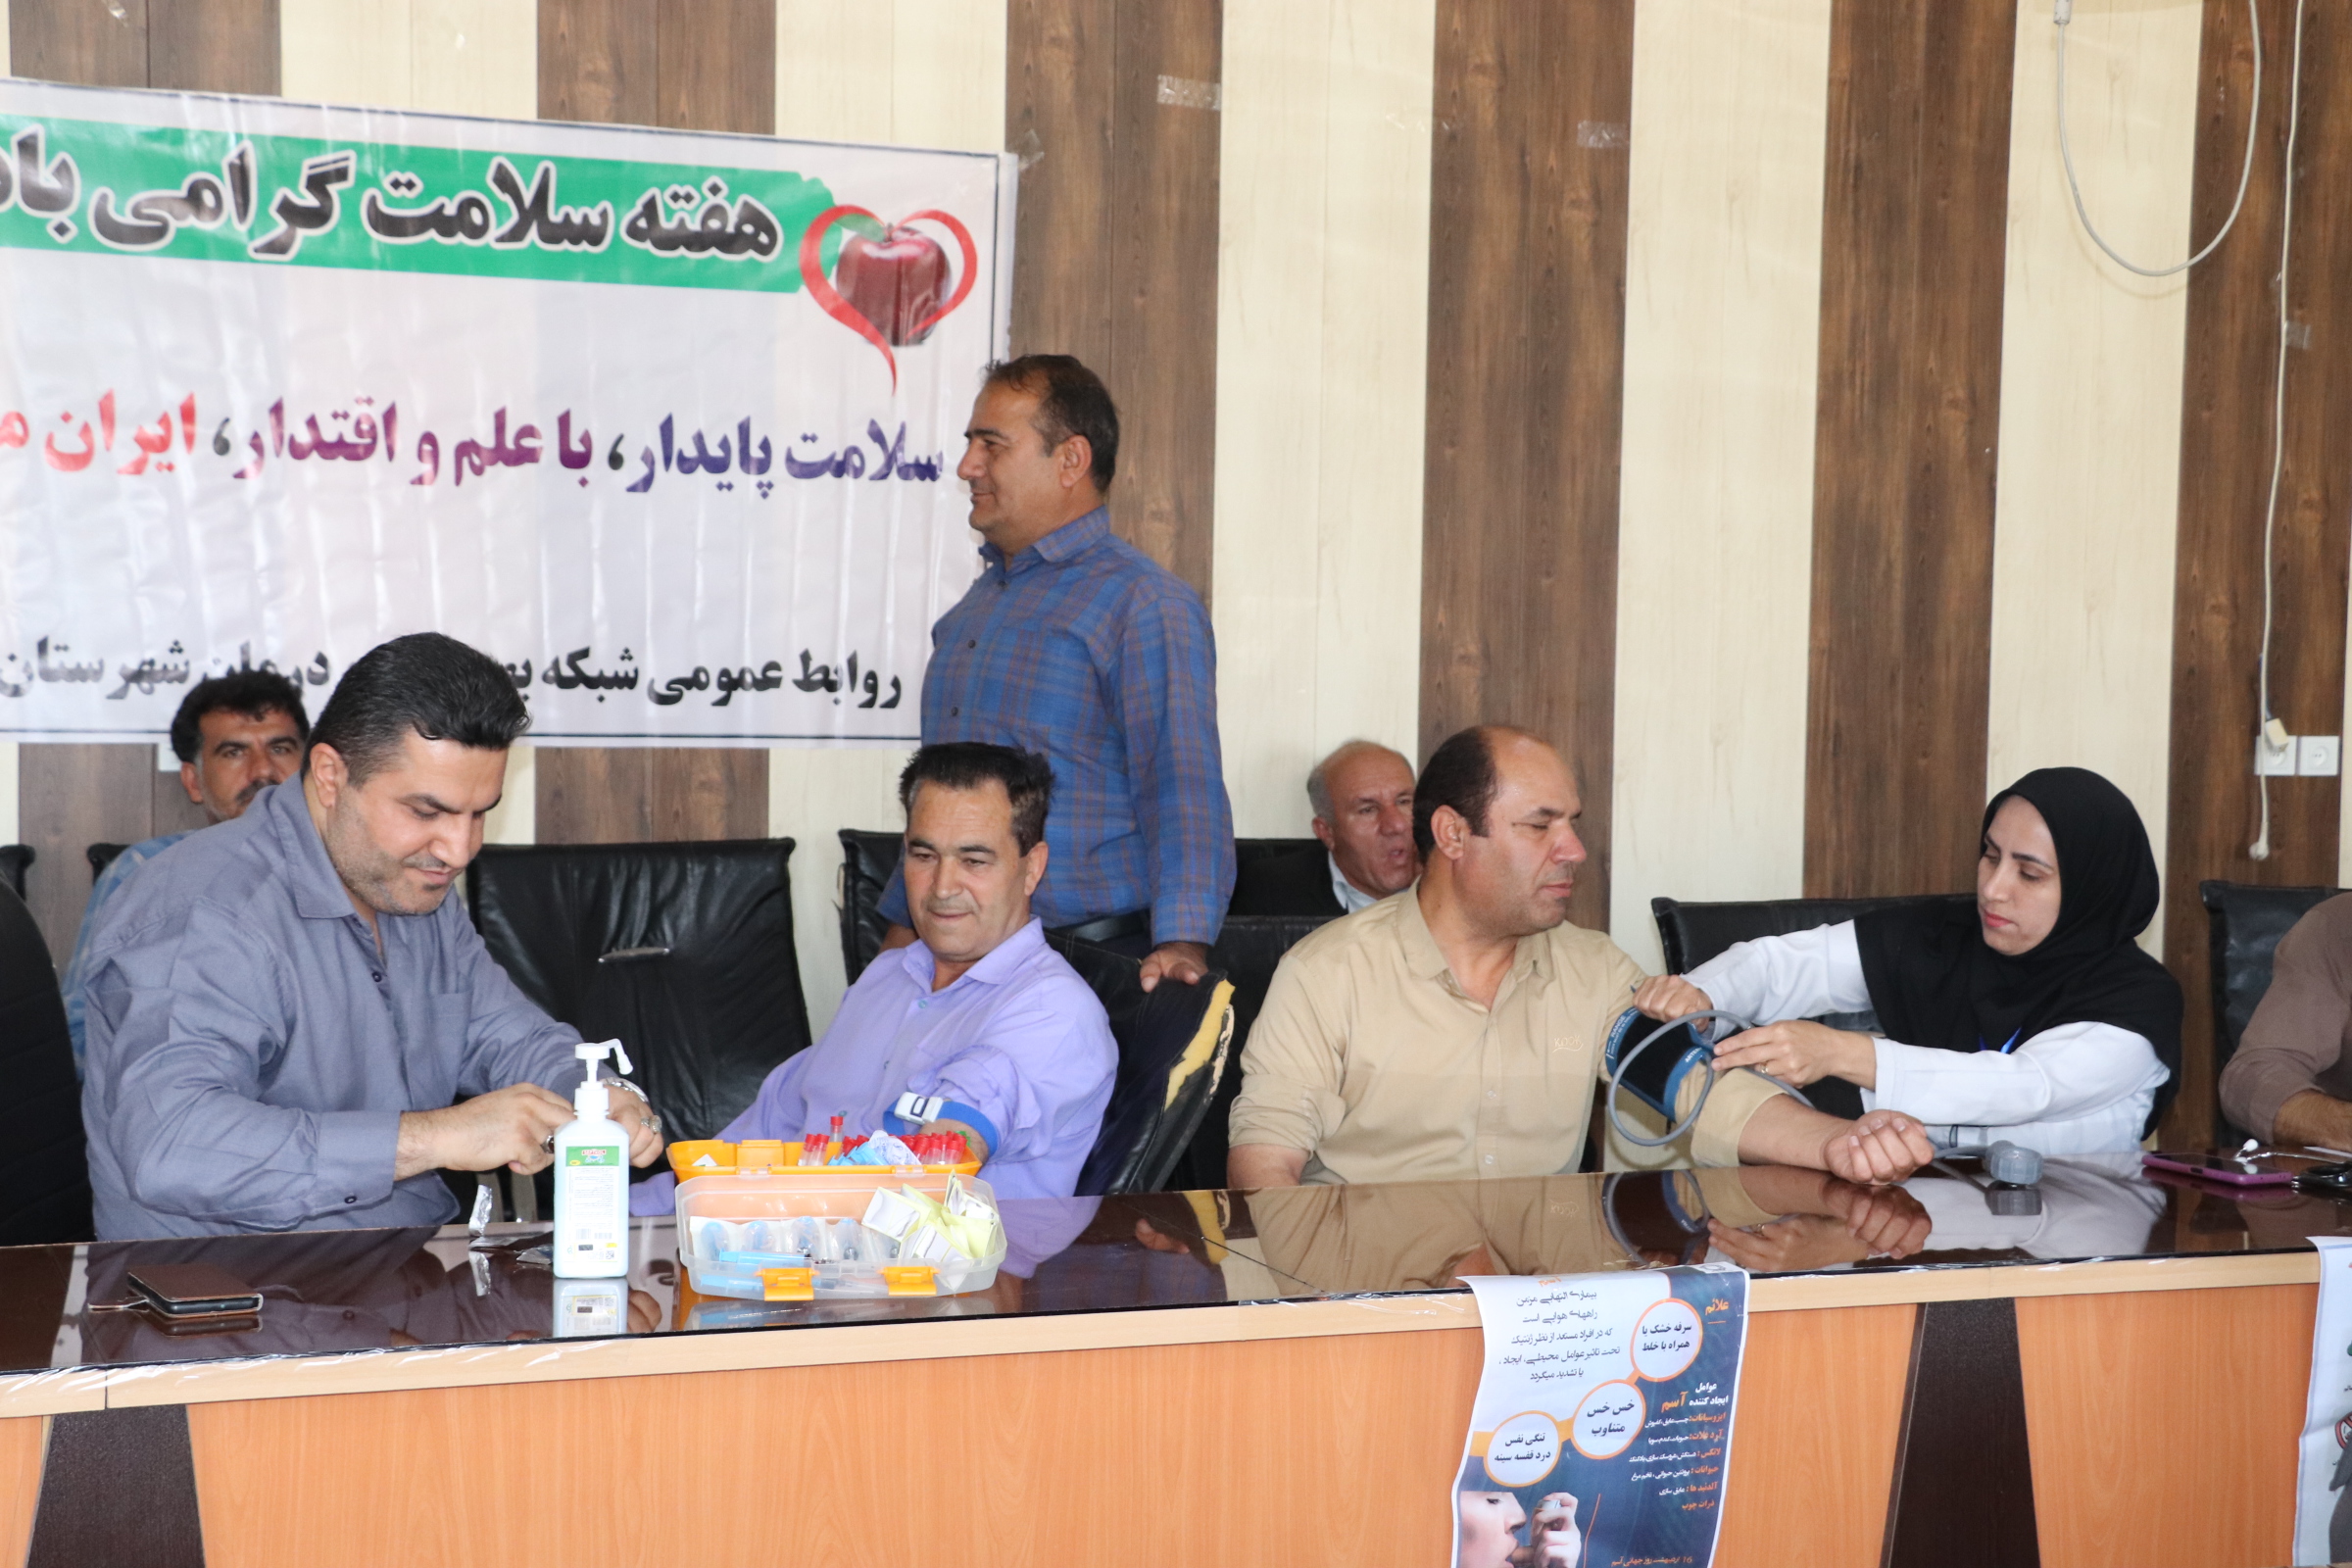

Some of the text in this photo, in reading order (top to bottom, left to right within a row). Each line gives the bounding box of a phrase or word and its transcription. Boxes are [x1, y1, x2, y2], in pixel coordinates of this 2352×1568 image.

[91, 143, 355, 258] گرامی
[365, 160, 612, 250] سلامت
[623, 177, 781, 260] هفته
[45, 389, 196, 475] ایران
[213, 396, 397, 479] اقتدار،
[454, 406, 543, 486] علم
[558, 409, 593, 487] با
[786, 418, 943, 481] سلامت
[410, 431, 440, 485] و
[608, 413, 772, 499] پایدار،
[542, 647, 639, 703] شبکه
[792, 648, 902, 709] روابط
[647, 660, 782, 706] عمومی
[1610, 1015, 1626, 1038] RANGE
[1516, 1290, 1597, 1307] بیماری التهابی مزمن
[1522, 1313, 1540, 1323] است
[1542, 1311, 1568, 1326] هوایی
[1556, 1332, 1579, 1341] مستعد
[1580, 1329, 1594, 1342] افراد
[1594, 1329, 1603, 1339] در
[1642, 1322, 1692, 1337] سرفه خشک یا
[1510, 1334, 1533, 1347] ژنتیک
[1534, 1333, 1548, 1347] نظر
[1548, 1332, 1555, 1344] از
[1642, 1340, 1690, 1351] همراه با خلط
[1561, 1349, 1585, 1362] عوامل
[1601, 1347, 1621, 1356] تحت
[1556, 1368, 1577, 1379] تشدید
[1579, 1368, 1585, 1377] یا
[1694, 1382, 1717, 1393] عوامل
[1587, 1399, 1635, 1417] خس خس
[1661, 1391, 1729, 1413] ایجاد کننده آسم
[1591, 1422, 1625, 1437] متناوب
[1505, 1433, 1545, 1446] تنگی نفس
[1494, 1450, 1551, 1463] درد قفسه سینه
